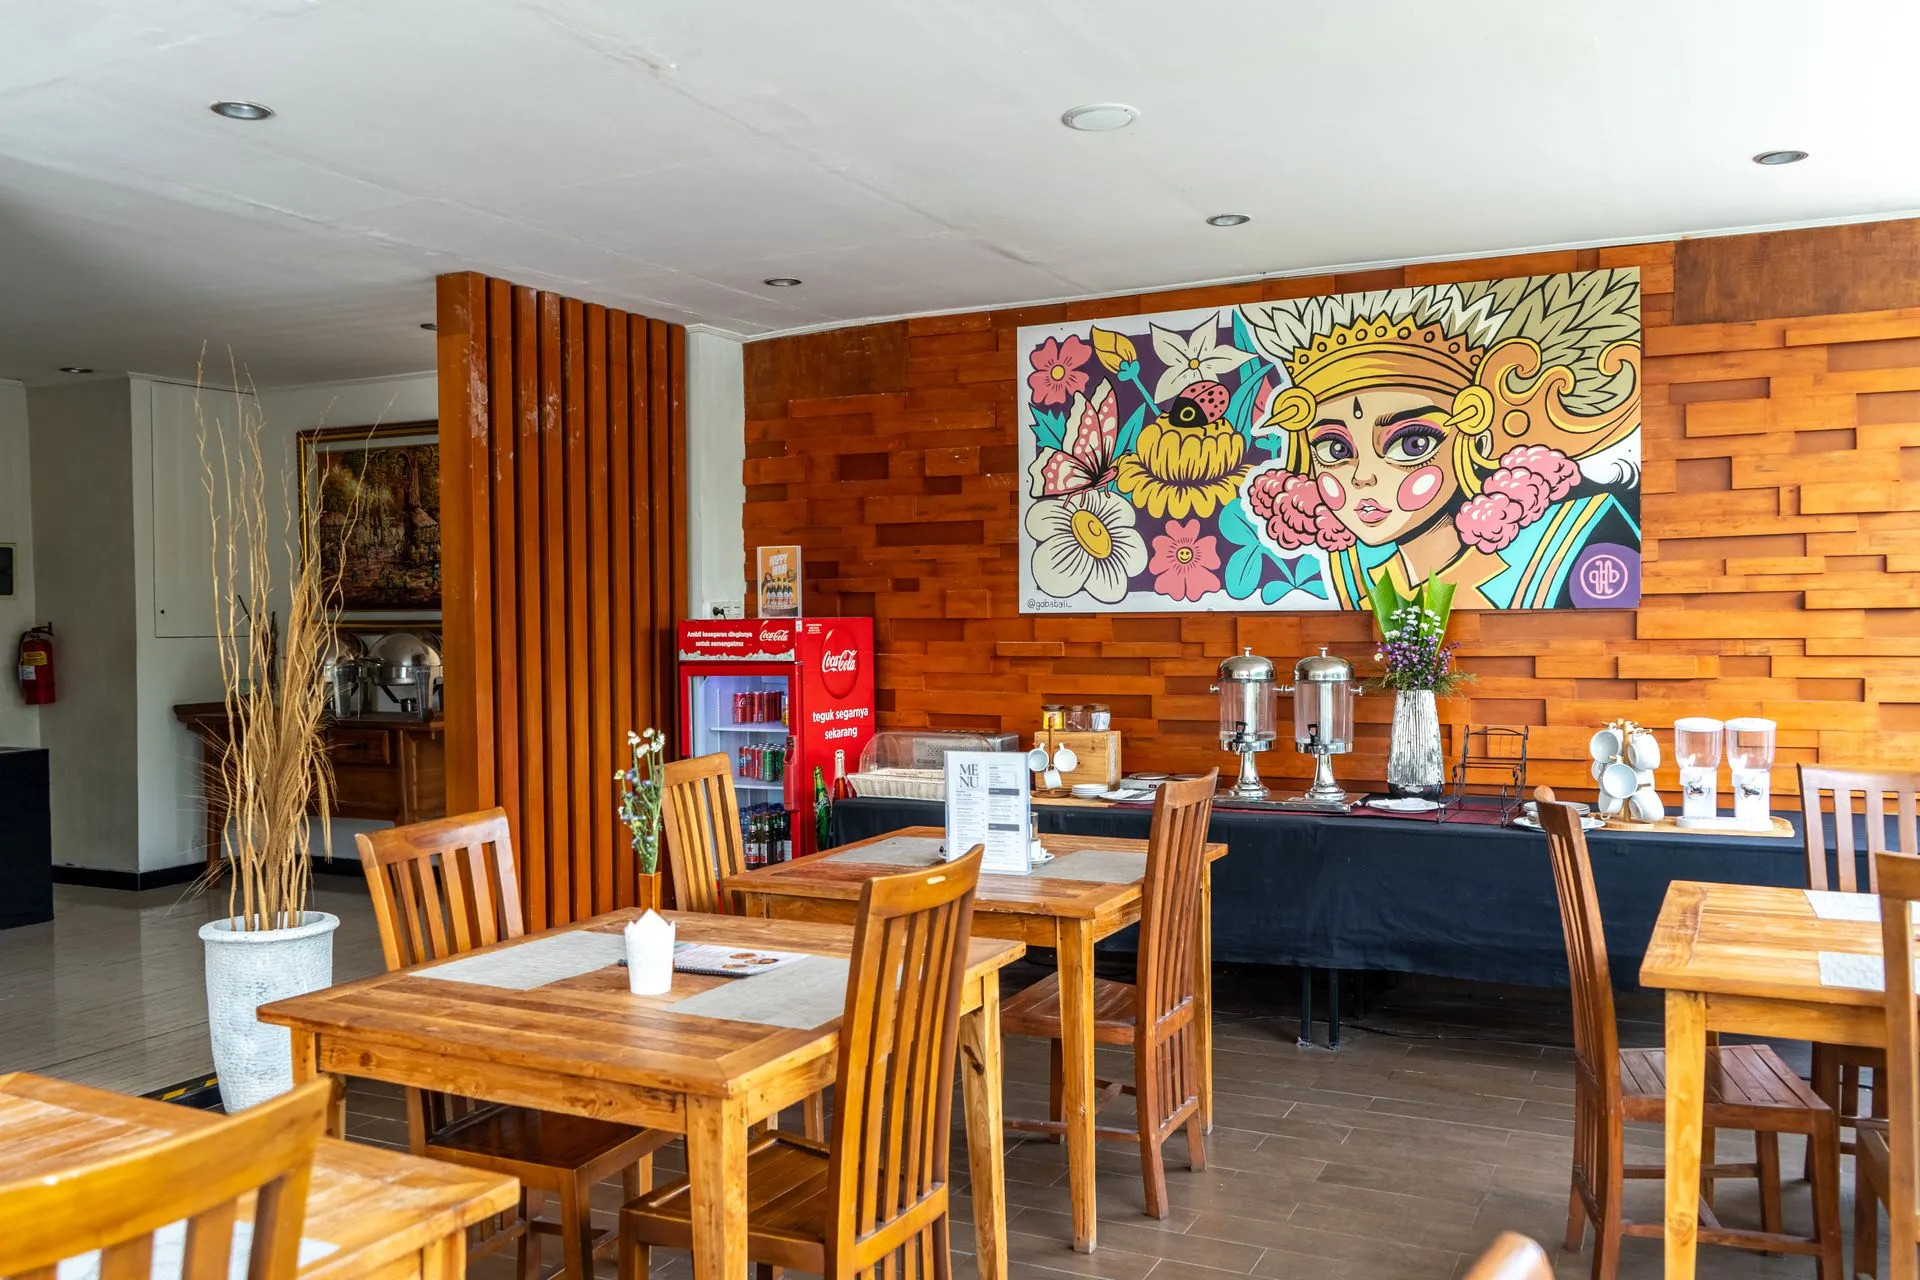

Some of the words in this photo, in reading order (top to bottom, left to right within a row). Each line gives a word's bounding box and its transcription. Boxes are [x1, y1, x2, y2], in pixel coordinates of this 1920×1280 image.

[812, 709, 835, 723] teguk
[835, 707, 868, 720] segarnya
[824, 727, 858, 740] sekarang
